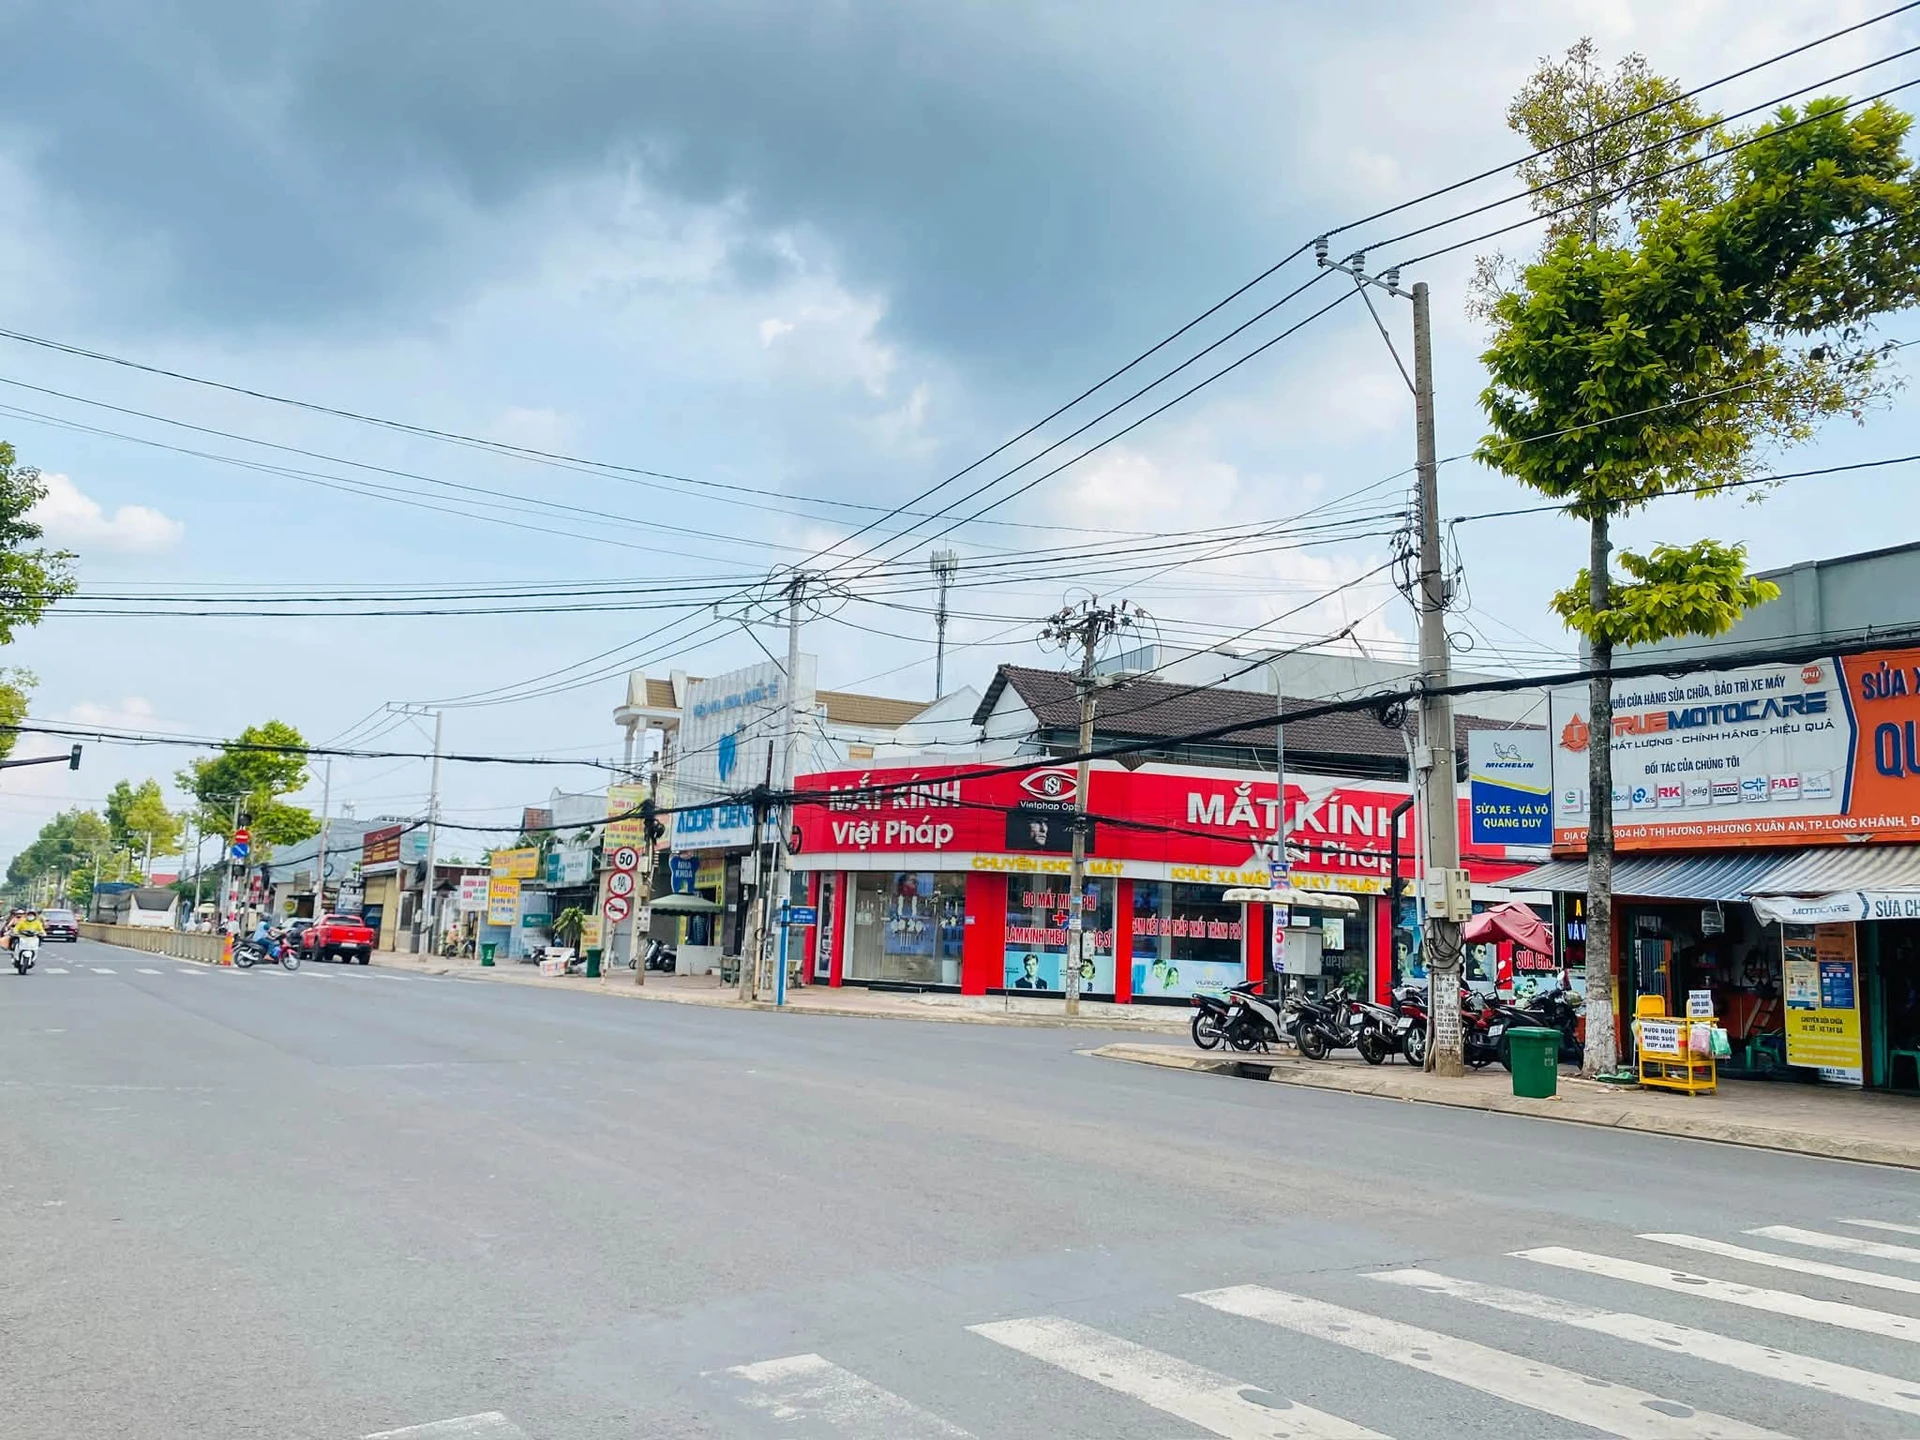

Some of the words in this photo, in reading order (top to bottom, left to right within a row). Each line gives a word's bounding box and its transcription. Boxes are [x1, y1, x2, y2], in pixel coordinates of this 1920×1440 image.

[1862, 661, 1909, 700] SỬA
[1627, 693, 1642, 707] CỦA
[1644, 691, 1666, 705] HÀNG
[1668, 686, 1685, 701] SỬA
[1687, 684, 1712, 699] CHỮA,
[1714, 680, 1732, 696] BẢO
[1735, 678, 1749, 693] TRÌ
[1751, 678, 1763, 690] XE
[1765, 675, 1786, 689] MÁY
[1611, 739, 1632, 751] HẤT
[1635, 736, 1673, 749] LƯỢNG
[1682, 730, 1719, 744] CHÍNH
[1770, 722, 1799, 737] HIỆU
[1805, 718, 1835, 731] QUẢ
[1645, 760, 1658, 775] ĐỐI
[1660, 758, 1676, 773] TÁC
[1677, 757, 1693, 772] CỦA
[1695, 755, 1723, 770] CHÚNG
[1725, 755, 1740, 768] TÔI
[1658, 787, 1680, 798] RK
[1771, 778, 1799, 789] FAG
[1187, 782, 1286, 829] MẮT
[1295, 796, 1407, 838] KÍNH
[1475, 802, 1496, 814] SỬA
[1499, 805, 1511, 814] XE
[1518, 803, 1532, 814] VÁ
[1534, 803, 1549, 814] VỎ
[832, 821, 880, 850] Việt
[885, 815, 954, 849] Pháp
[1483, 818, 1520, 829] QUANG
[1522, 818, 1542, 828] DUY
[1564, 831, 1579, 842] ĐỊA
[1613, 829, 1631, 838] 304
[1633, 825, 1646, 837] HỒ
[1650, 827, 1665, 838] THỊ
[1667, 825, 1705, 837] HƯƠNG,
[1707, 822, 1752, 834] PHƯỜNG
[1755, 820, 1785, 833] XUÂN
[1859, 814, 1908, 828] KHÁNH,
[620, 853, 633, 866] 50
[1041, 859, 1083, 874] KHO
[1875, 895, 1902, 917] SỬA
[1044, 928, 1066, 946] THEO
